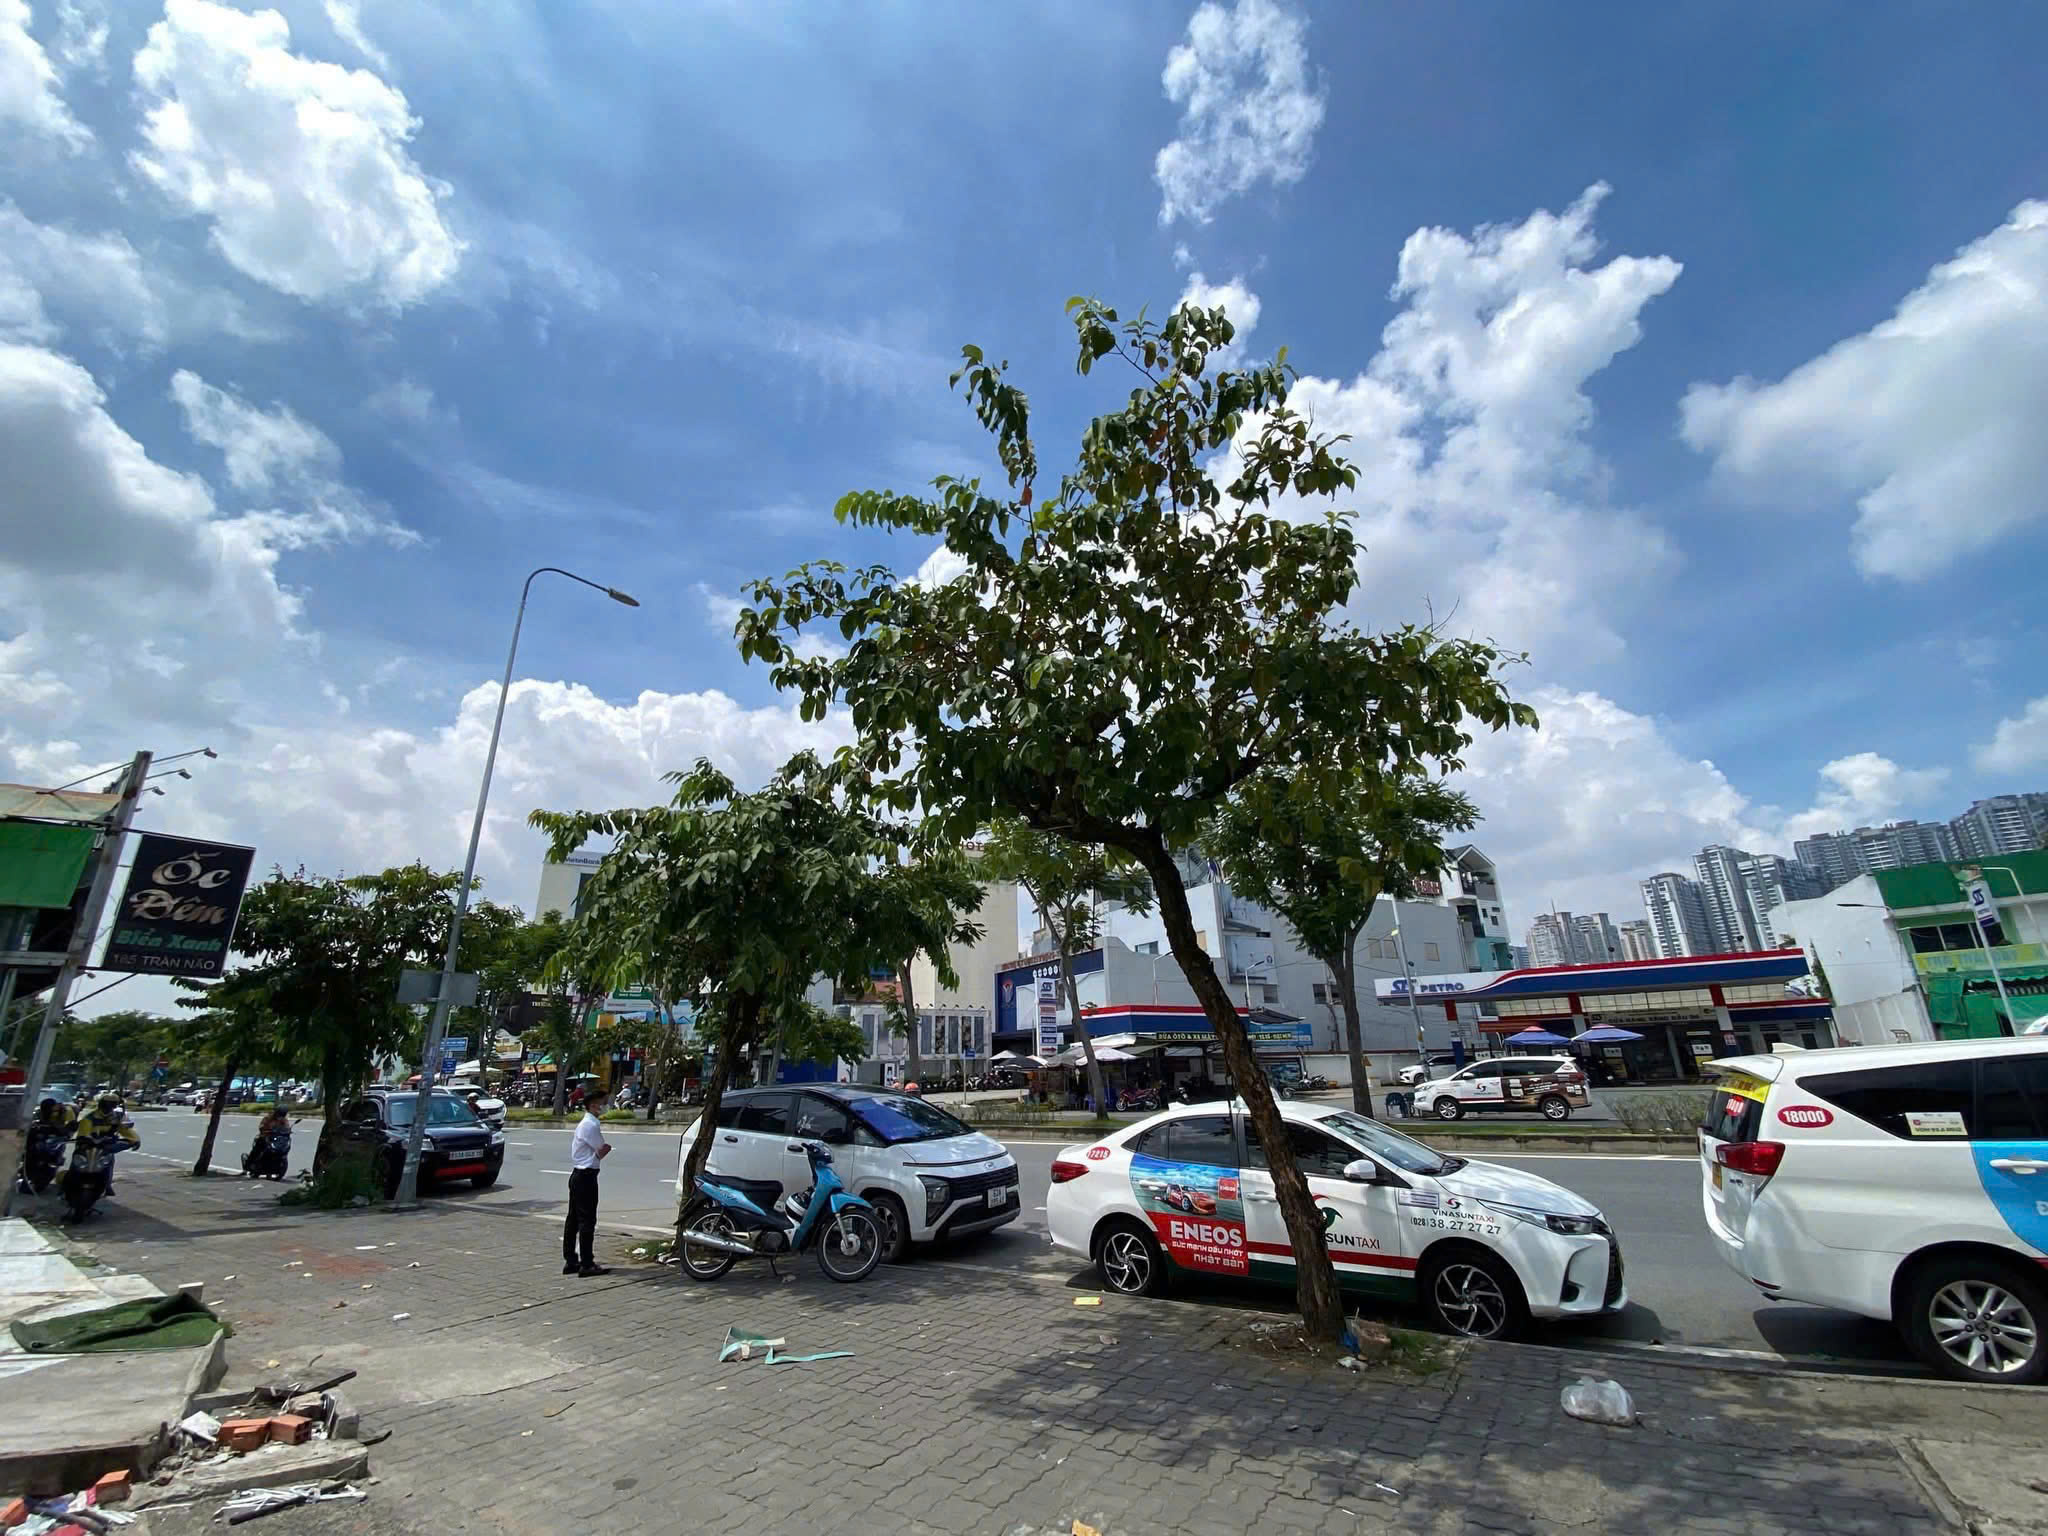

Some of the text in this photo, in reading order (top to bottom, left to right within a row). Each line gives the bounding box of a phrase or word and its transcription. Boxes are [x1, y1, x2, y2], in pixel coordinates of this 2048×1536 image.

[152, 851, 231, 888] Ốc
[129, 889, 226, 925] Đêm
[1420, 982, 1464, 993] PETRO
[1783, 1110, 1826, 1123] 18000
[1170, 1220, 1243, 1247] ENEOS
[1467, 1222, 1482, 1233] 27
[1487, 1225, 1501, 1235] 27
[1326, 1232, 1381, 1250] SUNTAXI
